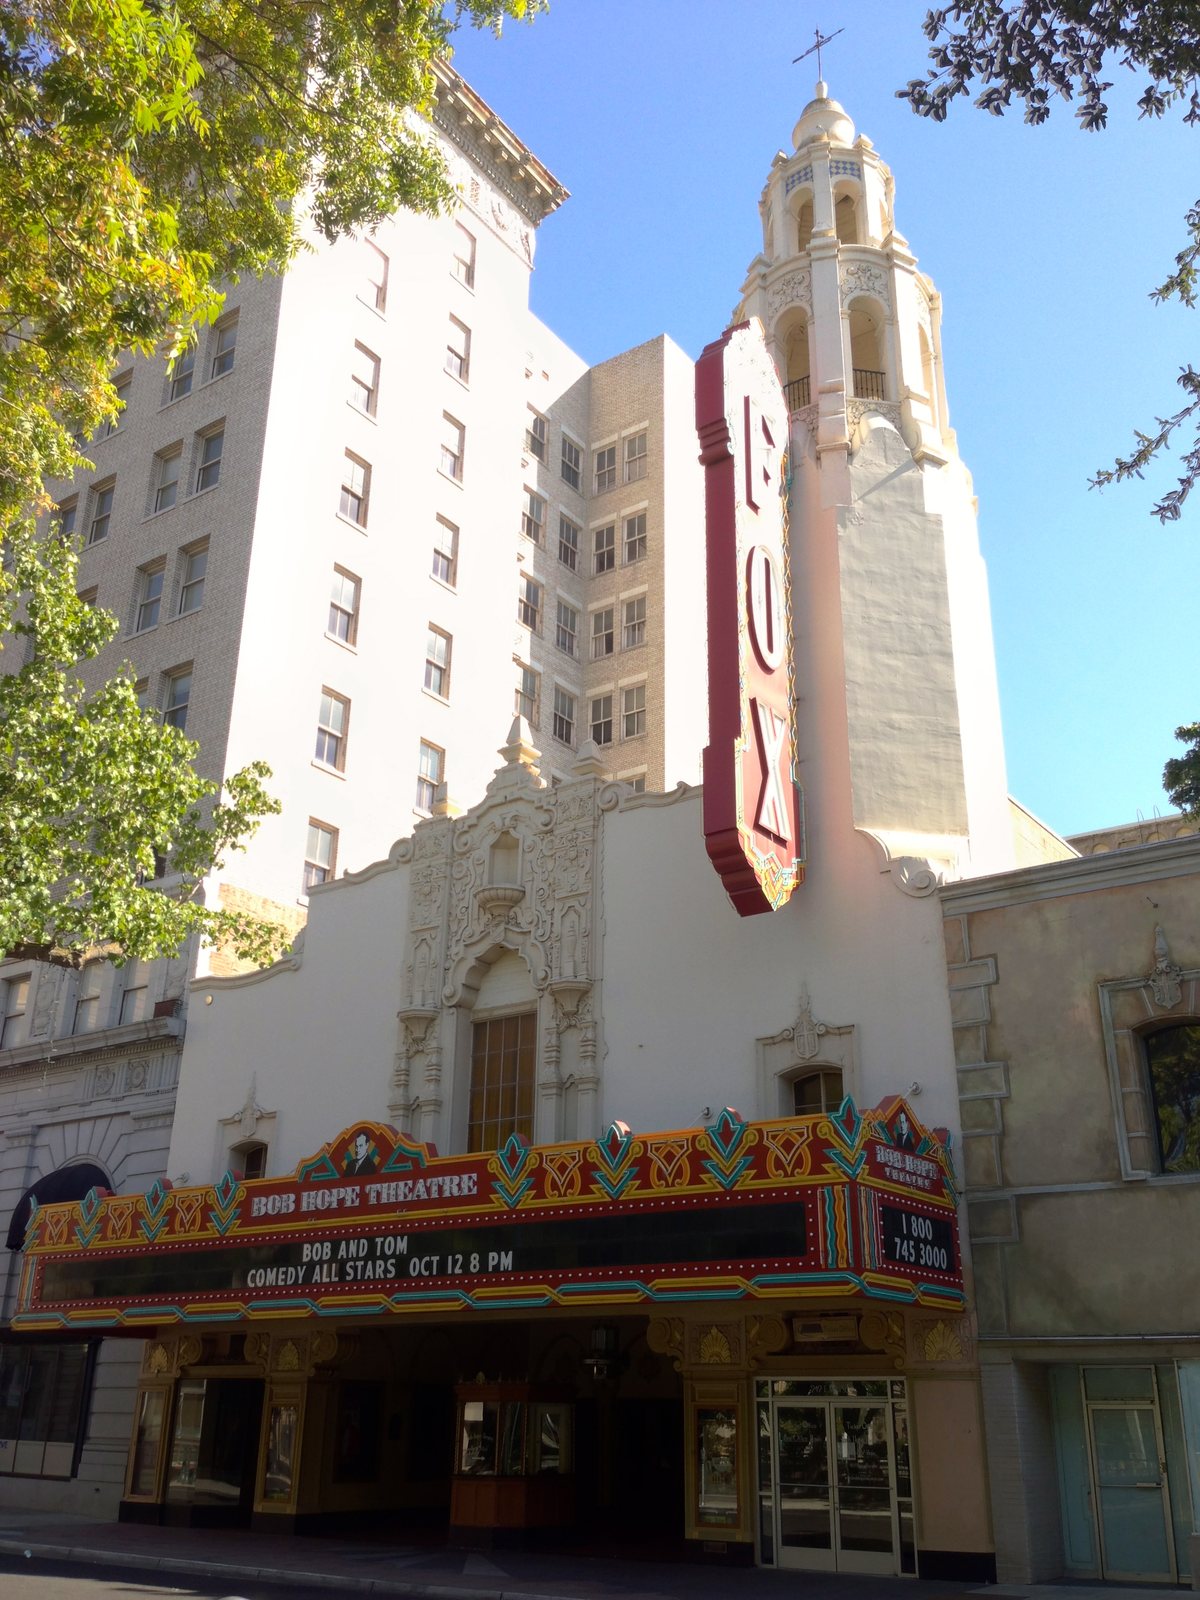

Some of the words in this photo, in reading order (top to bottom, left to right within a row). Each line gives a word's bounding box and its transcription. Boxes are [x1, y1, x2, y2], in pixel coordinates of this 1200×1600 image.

[745, 394, 790, 850] FOX
[251, 1195, 296, 1217] BOB
[300, 1186, 361, 1212] HOPE
[366, 1173, 478, 1205] THEATRE
[911, 1215, 933, 1240] 800
[302, 1242, 332, 1262] BOB
[338, 1239, 368, 1259] AND
[375, 1235, 409, 1255] TOM
[894, 1237, 915, 1263] 745
[919, 1243, 948, 1270] 3000
[247, 1264, 306, 1288] COMEDY
[311, 1262, 339, 1284] ALL
[345, 1258, 397, 1280] STARS
[408, 1255, 439, 1277] OCT
[447, 1252, 463, 1274] 12
[469, 1253, 480, 1272] 8
[488, 1250, 513, 1272] PM
